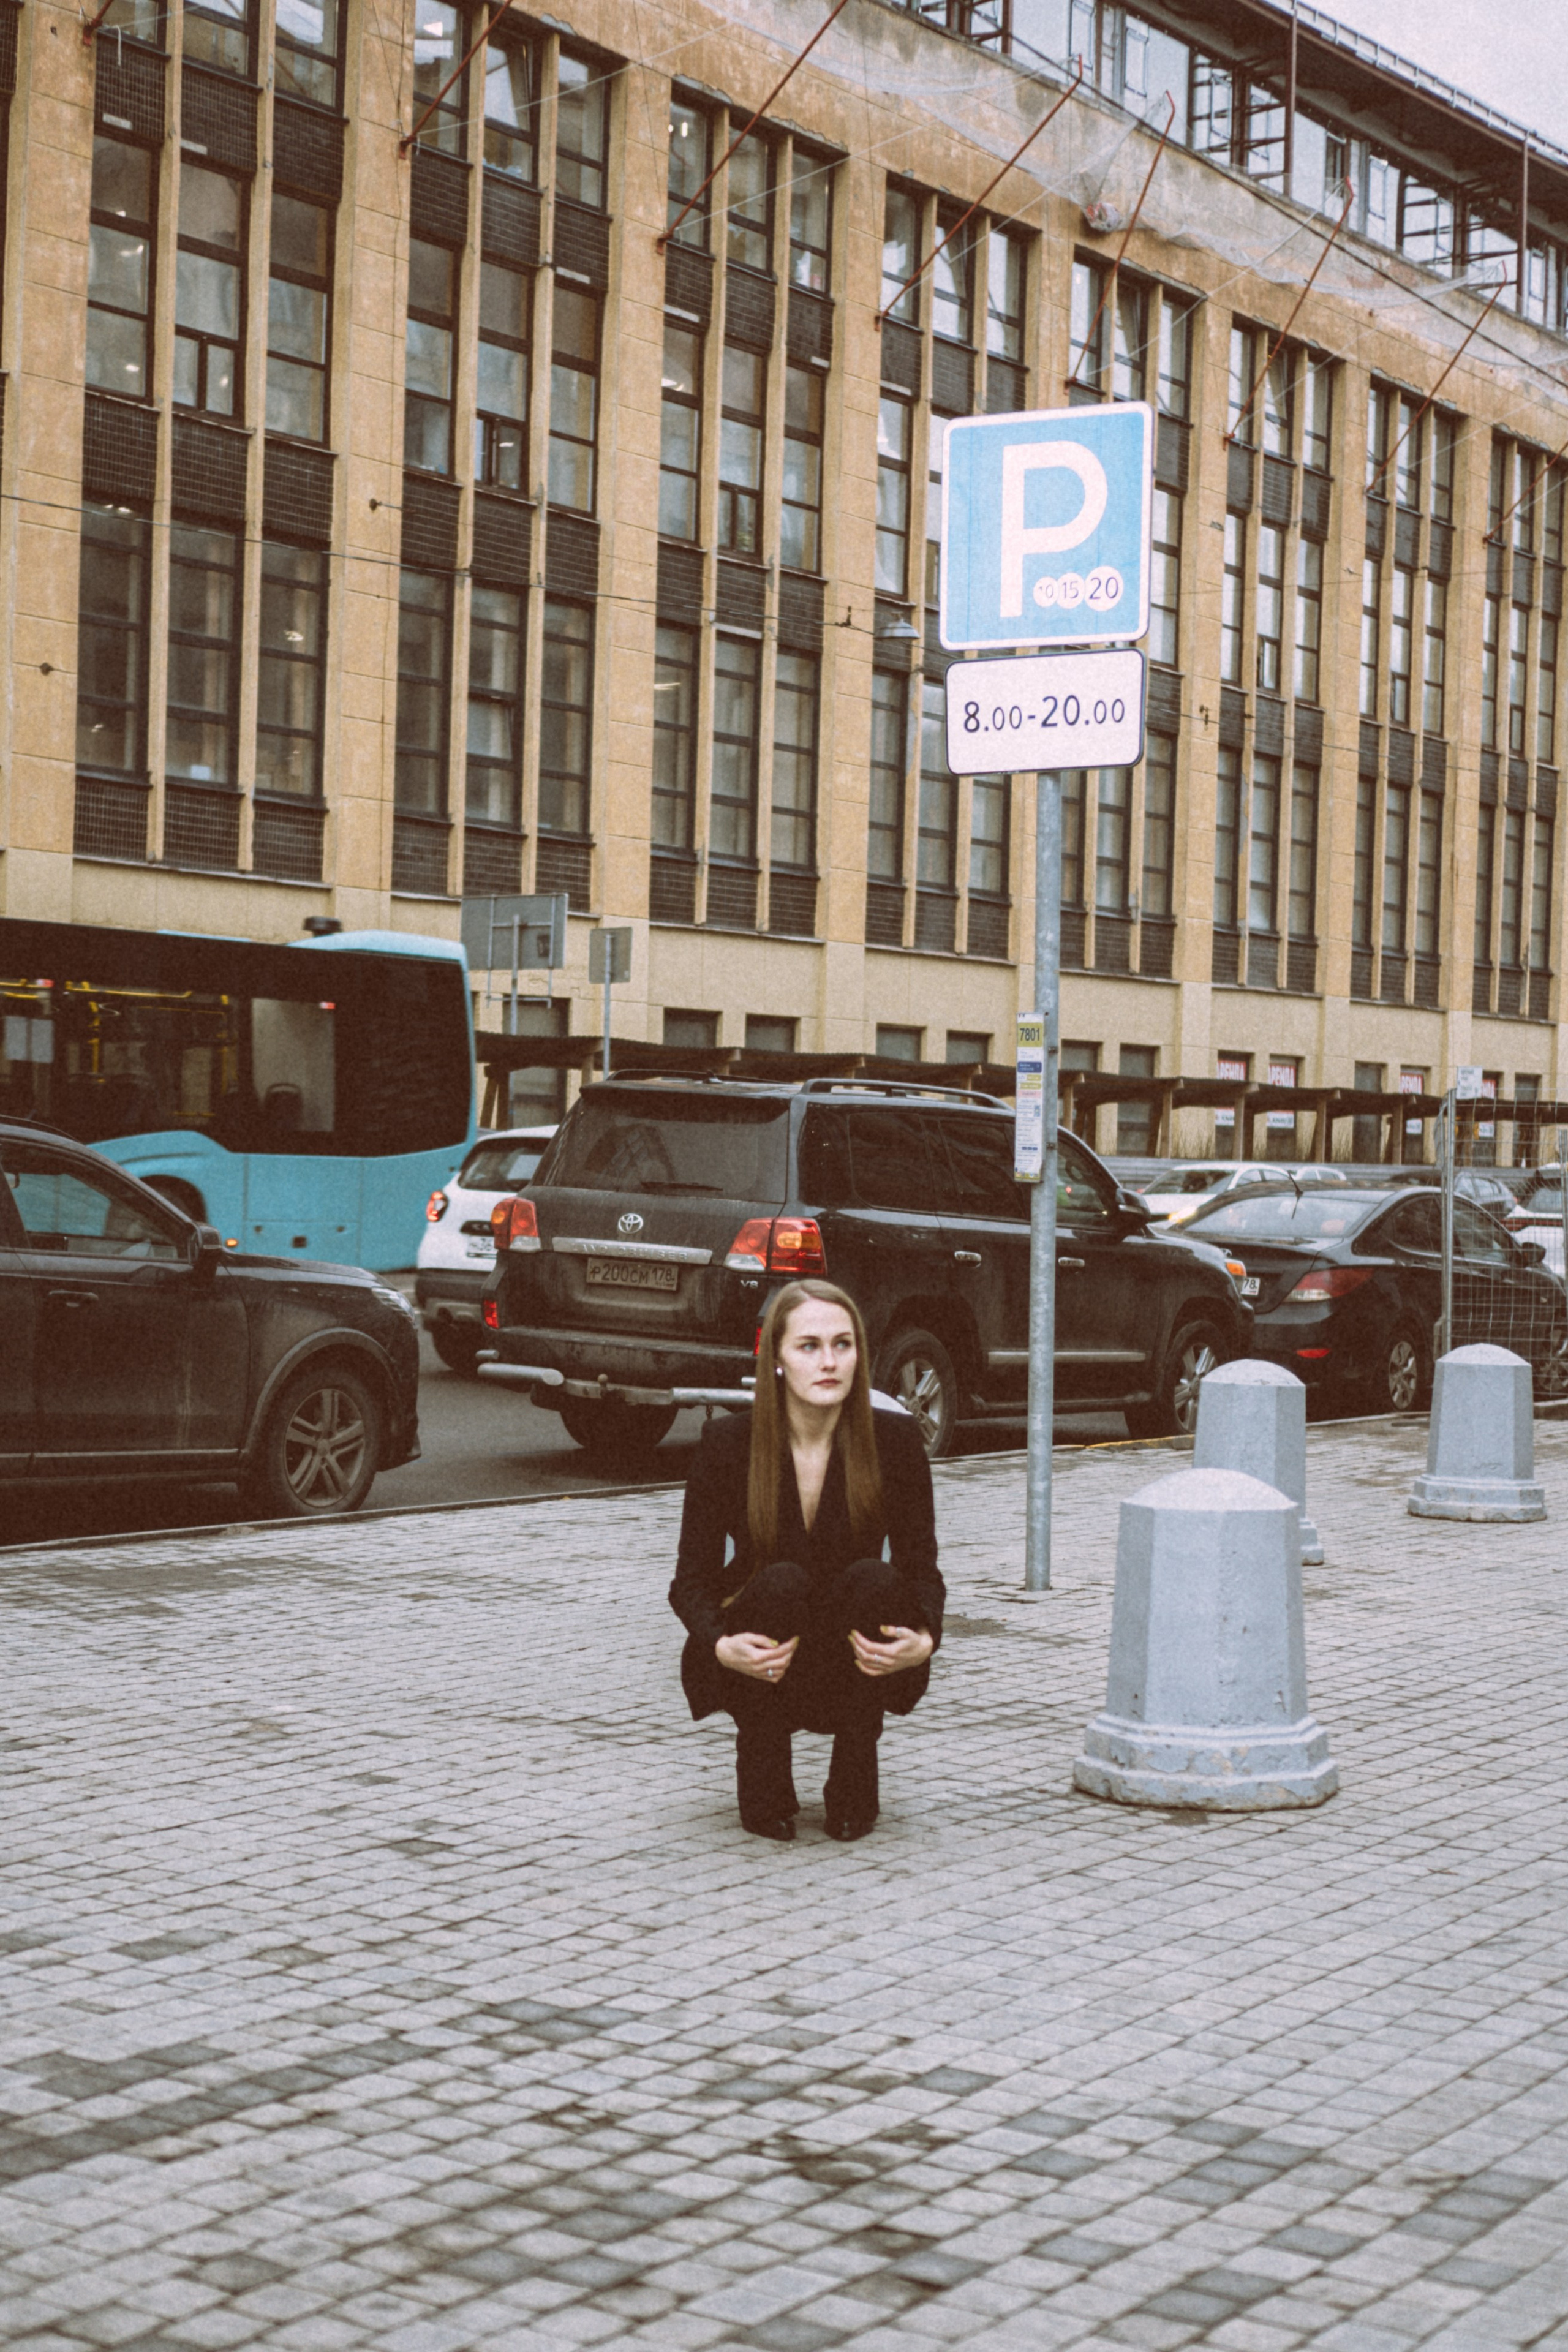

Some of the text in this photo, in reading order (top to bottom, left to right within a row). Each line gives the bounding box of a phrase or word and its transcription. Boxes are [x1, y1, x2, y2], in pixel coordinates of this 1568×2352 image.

[1000, 440, 1108, 618] P
[1062, 581, 1079, 599] 15
[1088, 576, 1119, 600] 20
[963, 695, 1125, 733] 8.00-20.00
[1019, 1027, 1040, 1042] 7801
[571, 1243, 688, 1261] LAND CRUISER
[740, 1280, 758, 1289] V8
